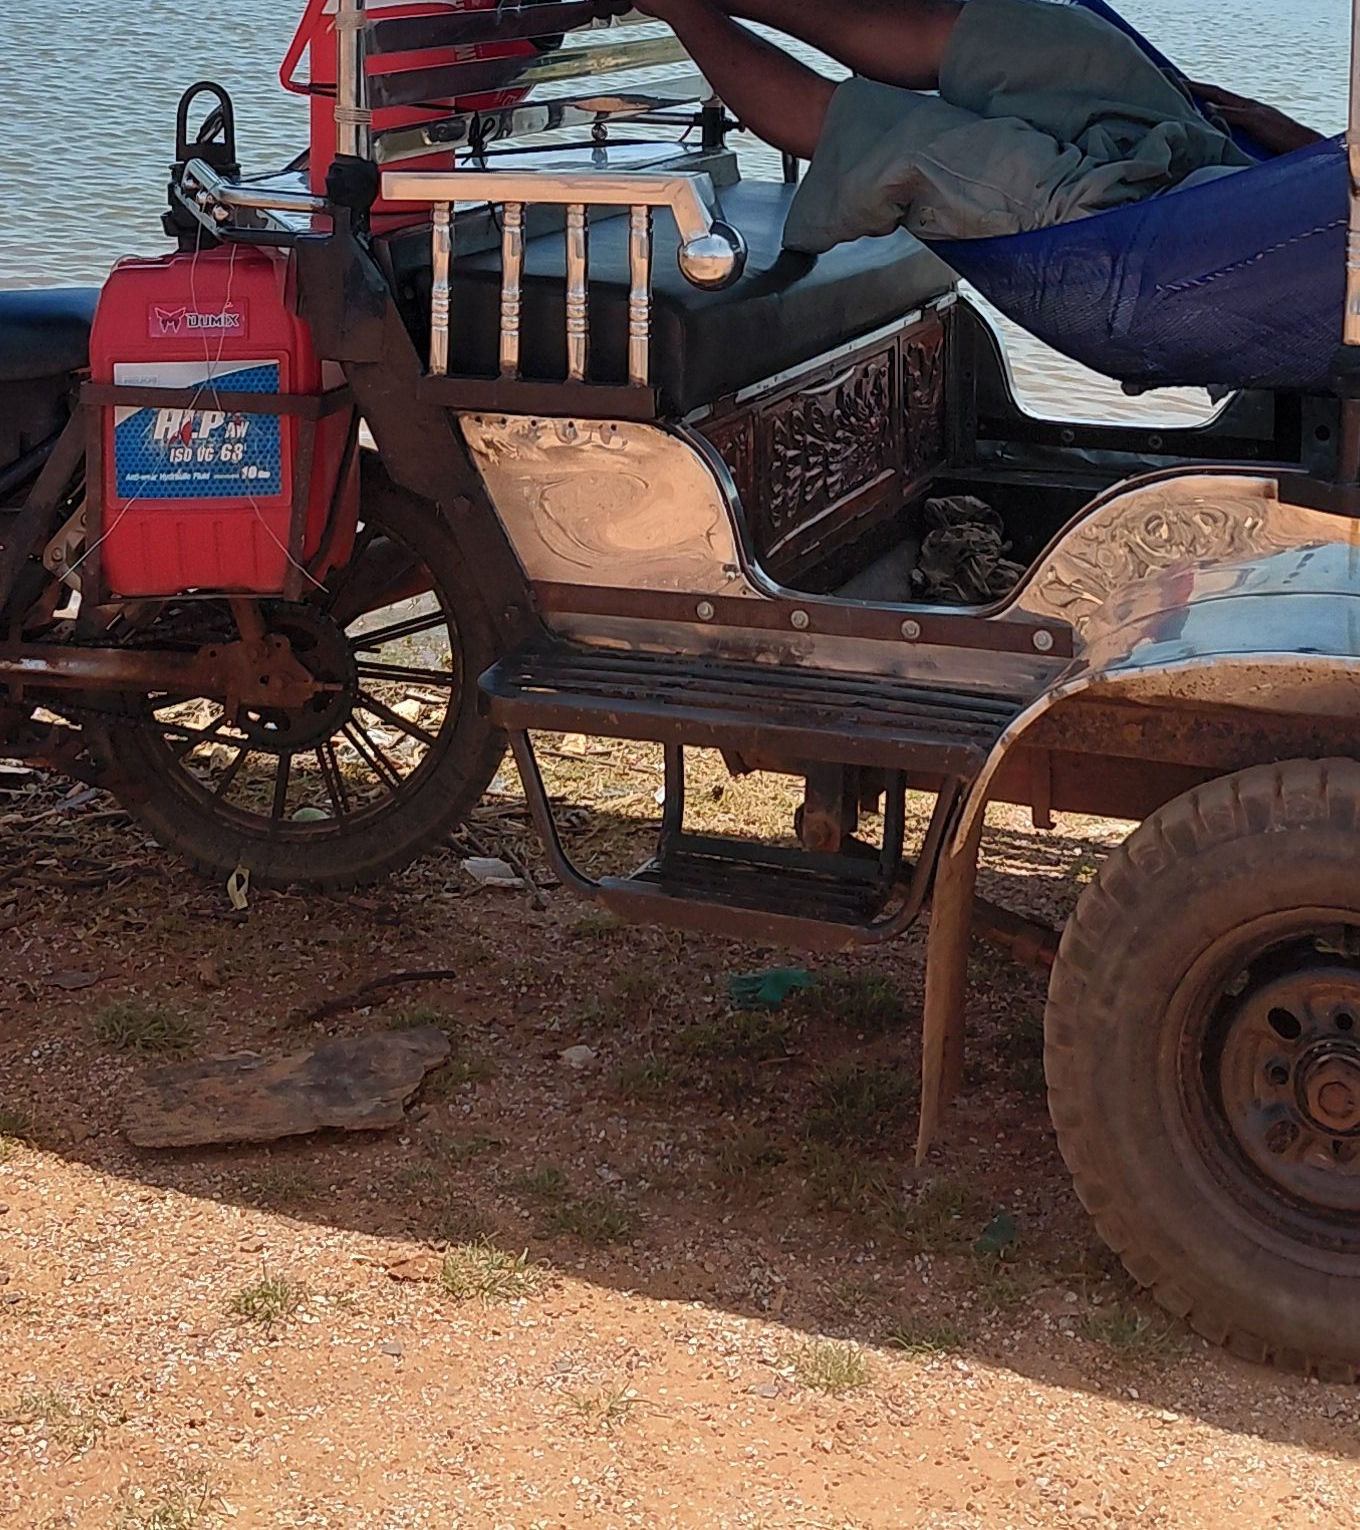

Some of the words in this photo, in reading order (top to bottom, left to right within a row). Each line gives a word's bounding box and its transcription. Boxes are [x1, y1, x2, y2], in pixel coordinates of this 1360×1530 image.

[169, 447, 193, 463] ISO
[197, 447, 215, 462] VG
[219, 443, 244, 462] 68
